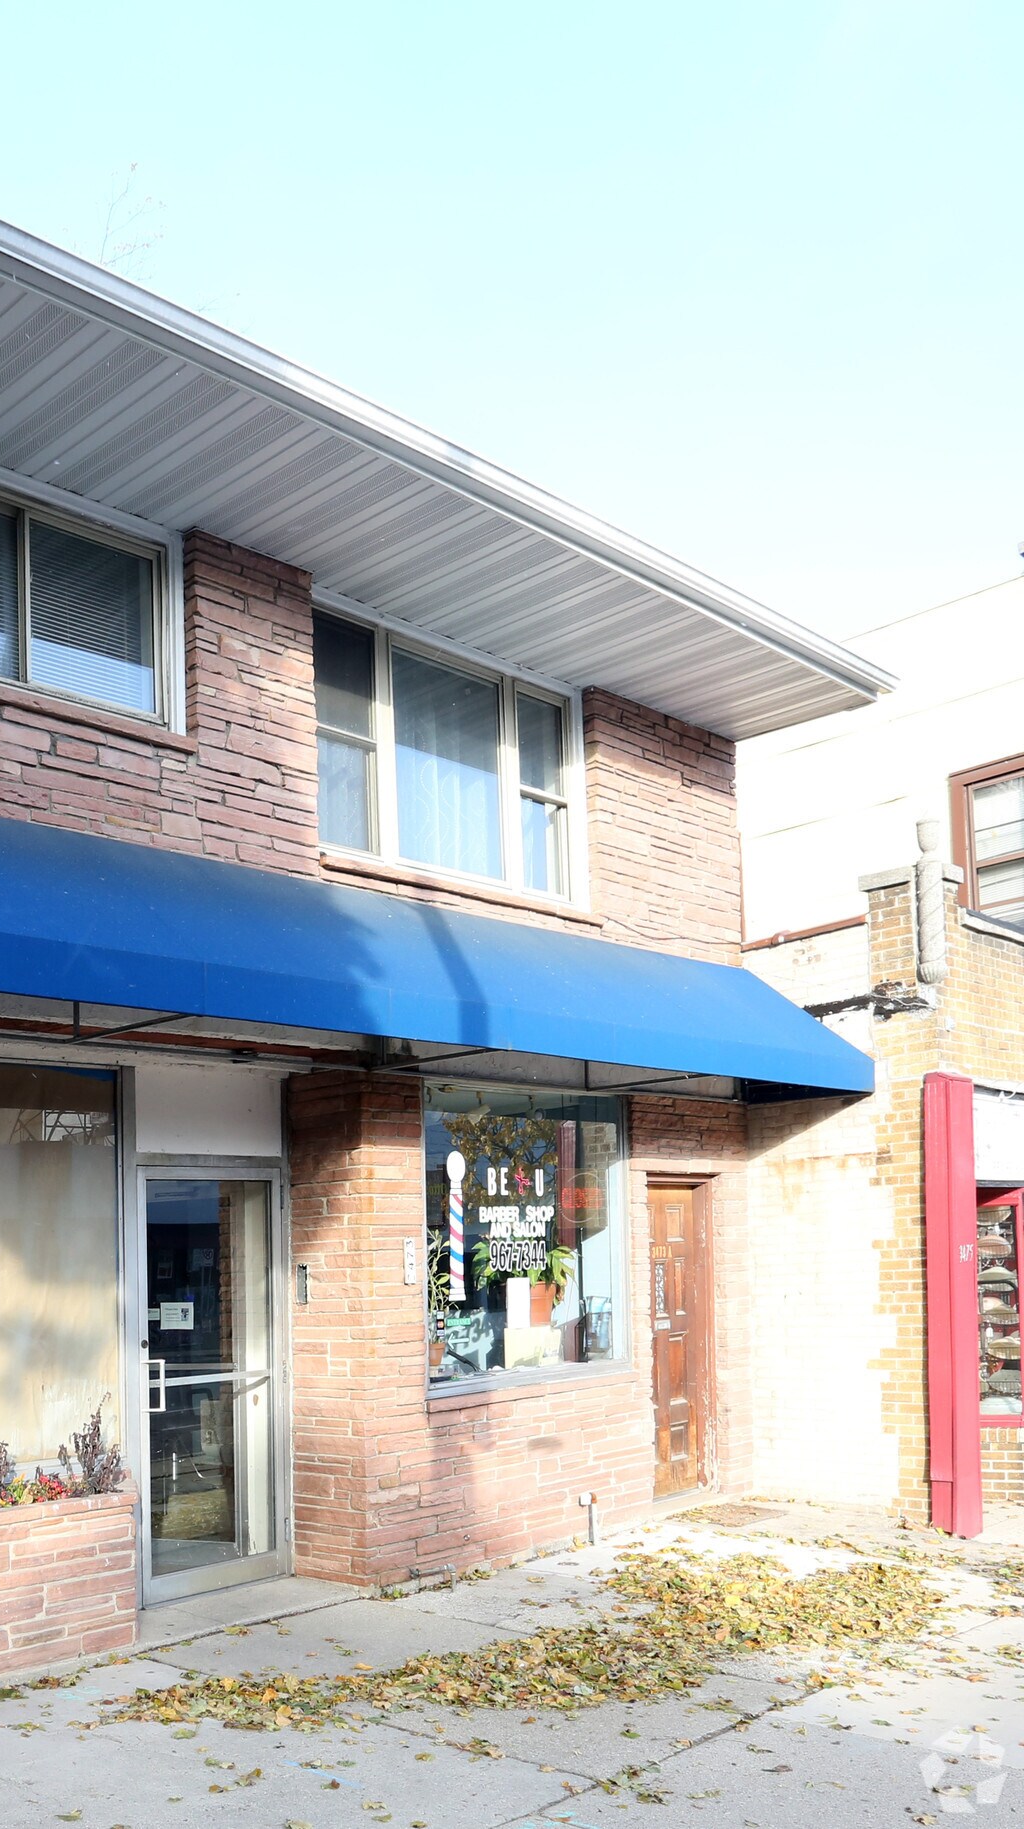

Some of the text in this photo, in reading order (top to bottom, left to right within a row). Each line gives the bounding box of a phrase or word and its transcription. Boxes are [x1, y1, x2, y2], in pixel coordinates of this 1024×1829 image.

[487, 1167, 544, 1197] BE U
[478, 1205, 555, 1223] BARBER SHOP
[489, 1221, 546, 1239] AND SALON
[489, 1240, 547, 1272] 967-7344
